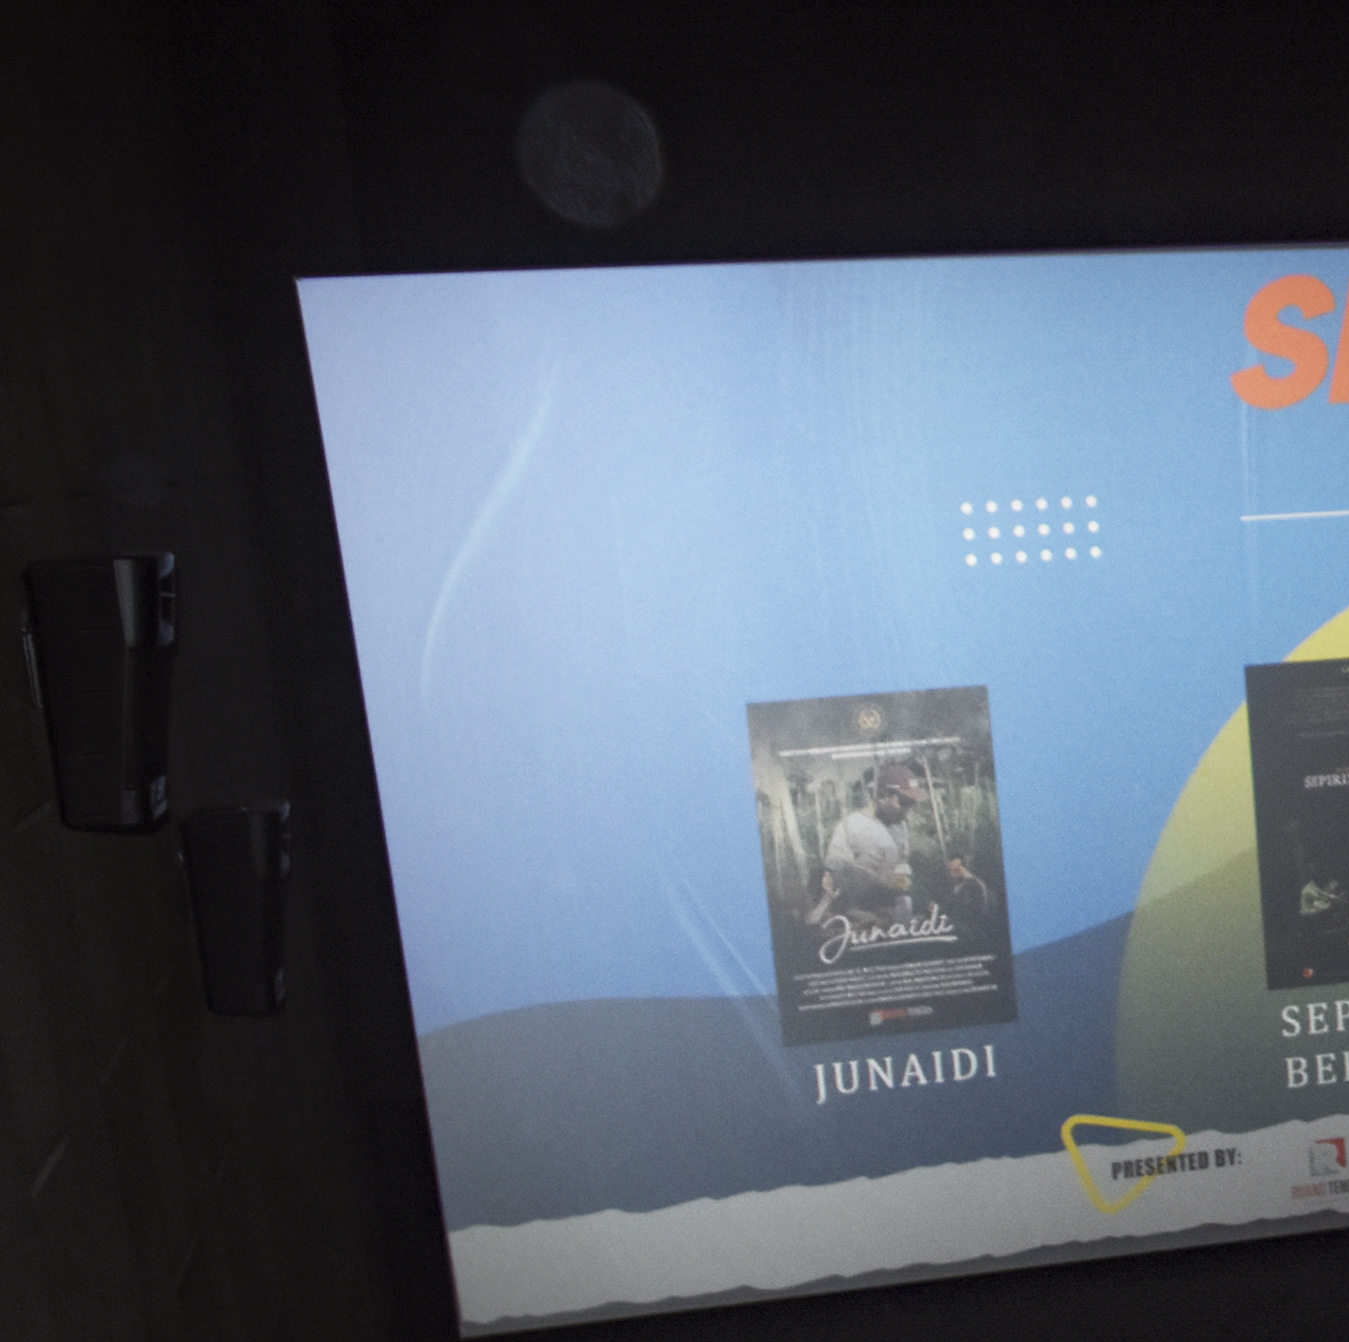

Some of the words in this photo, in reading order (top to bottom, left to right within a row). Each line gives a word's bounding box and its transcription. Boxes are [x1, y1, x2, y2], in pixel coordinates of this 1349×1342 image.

[813, 1044, 998, 1105] JUNAIDI
[1110, 1154, 1209, 1181] PRESENTED
[1214, 1147, 1243, 1168] BY:
